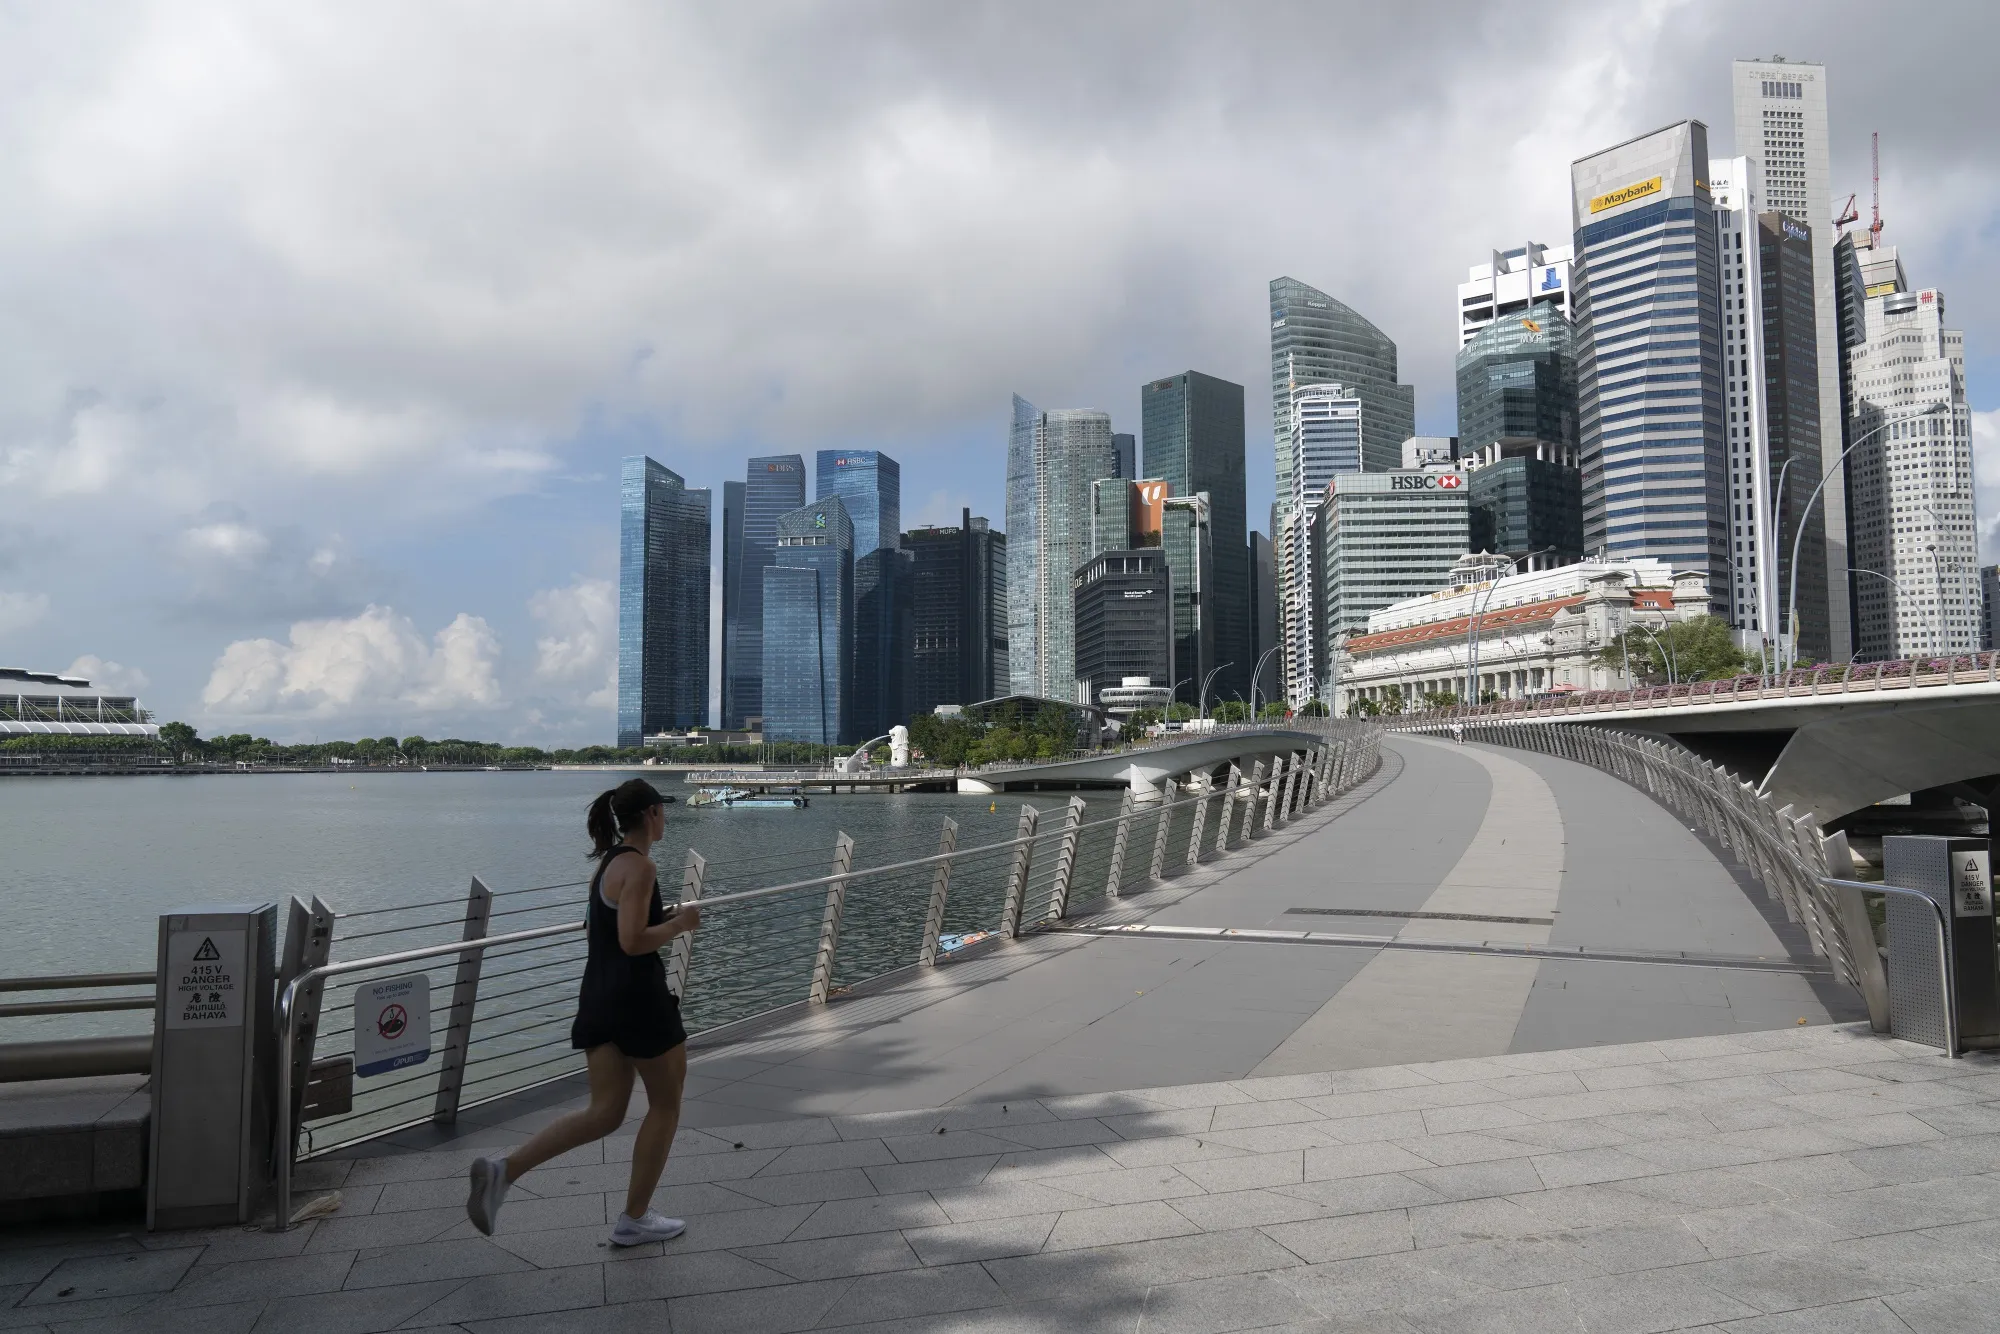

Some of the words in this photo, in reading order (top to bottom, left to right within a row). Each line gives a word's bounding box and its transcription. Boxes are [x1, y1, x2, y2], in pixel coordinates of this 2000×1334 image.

[1603, 181, 1654, 206] Maybank
[1521, 332, 1543, 344] MYP
[847, 457, 866, 465] HSBC
[776, 464, 794, 472] DBS
[1391, 475, 1436, 490] HSBC
[190, 965, 212, 975] 415
[214, 965, 223, 974] V
[182, 974, 230, 985] DANGER
[199, 983, 235, 991] VOLTAGE
[372, 986, 384, 996] NO
[385, 981, 413, 992] FISHING
[183, 1011, 227, 1021] BAHAYA
[400, 1055, 414, 1065] PUB
